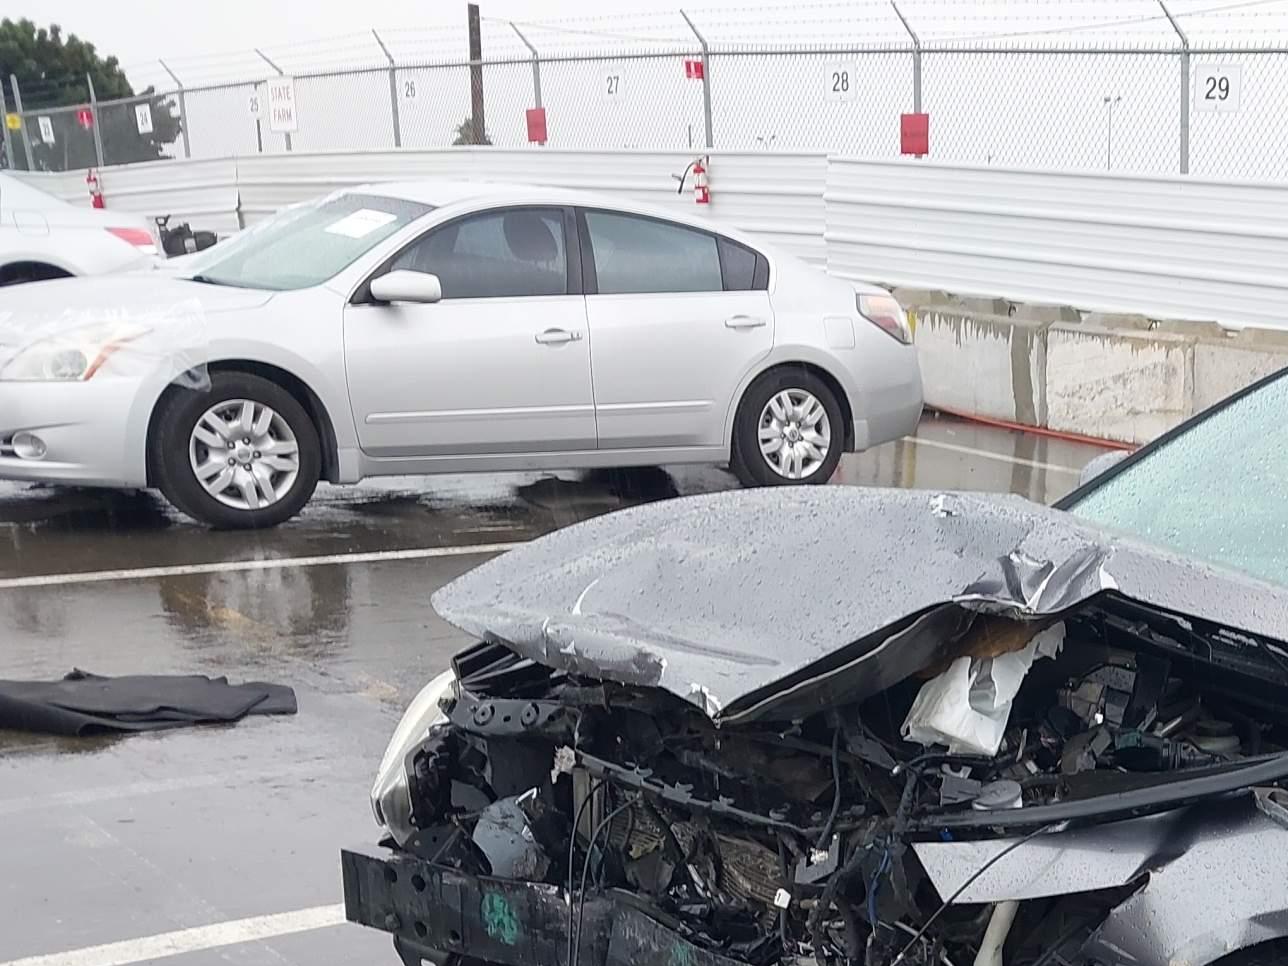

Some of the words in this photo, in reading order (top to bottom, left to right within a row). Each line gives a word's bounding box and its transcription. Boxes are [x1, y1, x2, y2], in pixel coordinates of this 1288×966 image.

[405, 81, 416, 98] 26
[606, 76, 620, 94] 27
[832, 71, 849, 92] 28
[1205, 76, 1230, 101] 29
[271, 85, 291, 101] STATE
[273, 107, 293, 122] FARM
